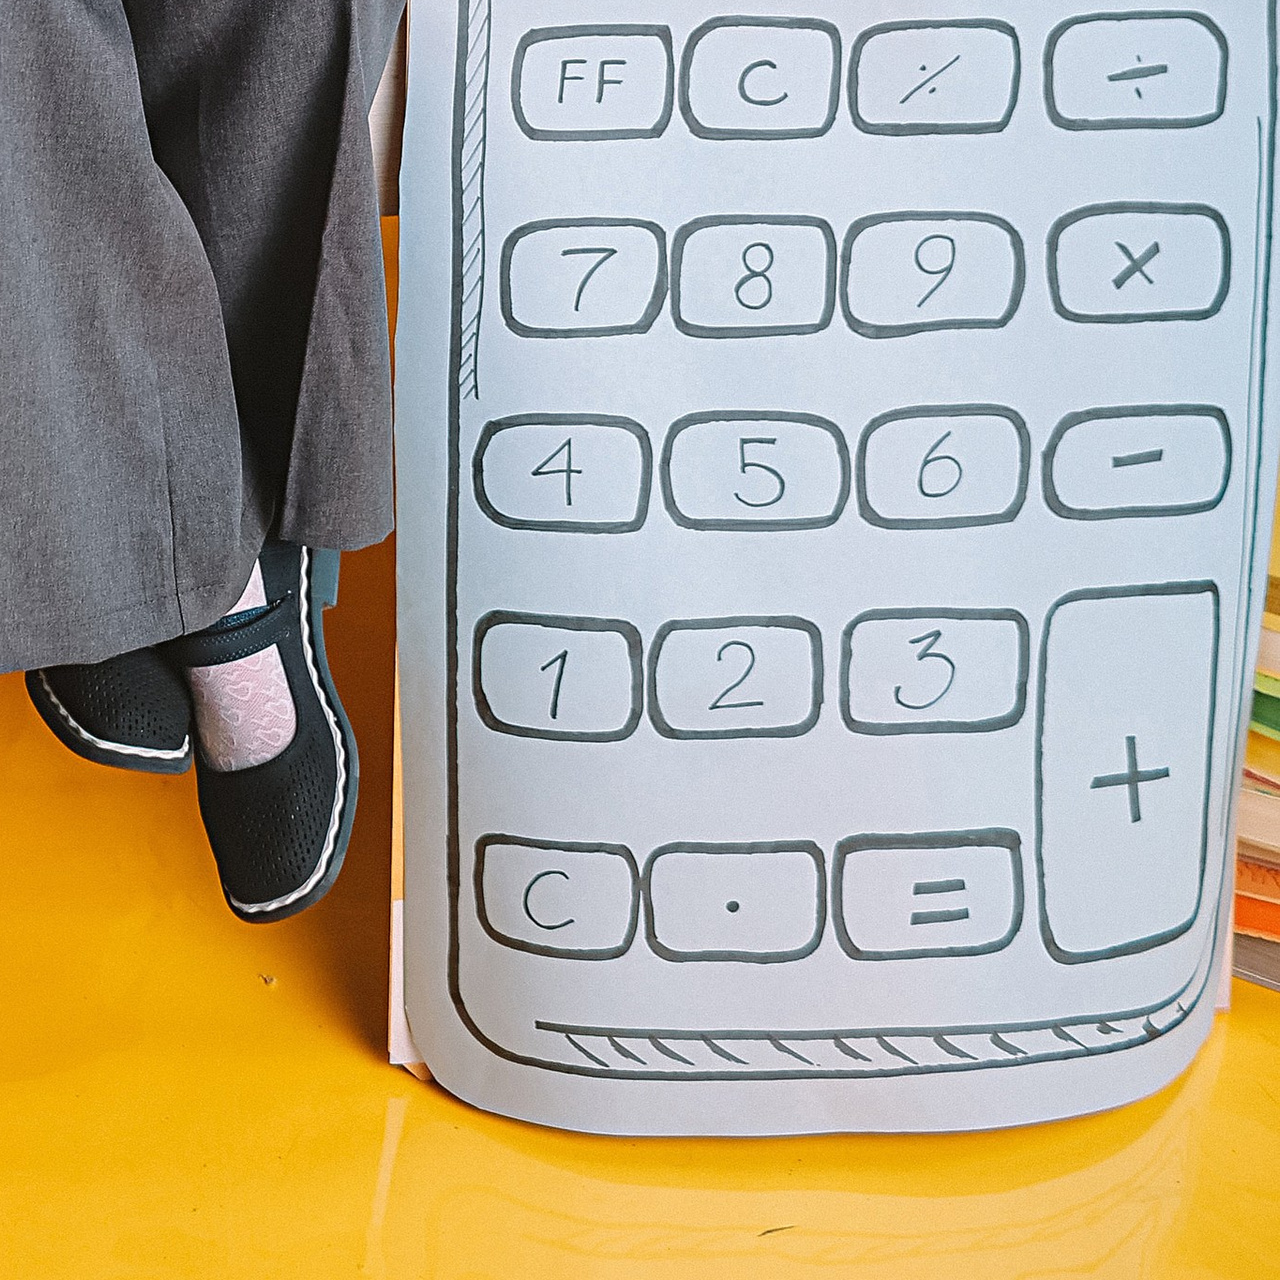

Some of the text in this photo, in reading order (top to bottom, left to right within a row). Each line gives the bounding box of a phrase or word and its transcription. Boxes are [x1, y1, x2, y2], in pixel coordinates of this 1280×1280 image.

[558, 59, 627, 104] FF
[561, 247, 618, 312] 7
[734, 242, 775, 310] 8
[914, 234, 957, 308] 9
[531, 438, 583, 506] 4
[734, 437, 786, 508] 5
[917, 431, 963, 498] 6
[540, 629, 956, 720] 1 2 3
